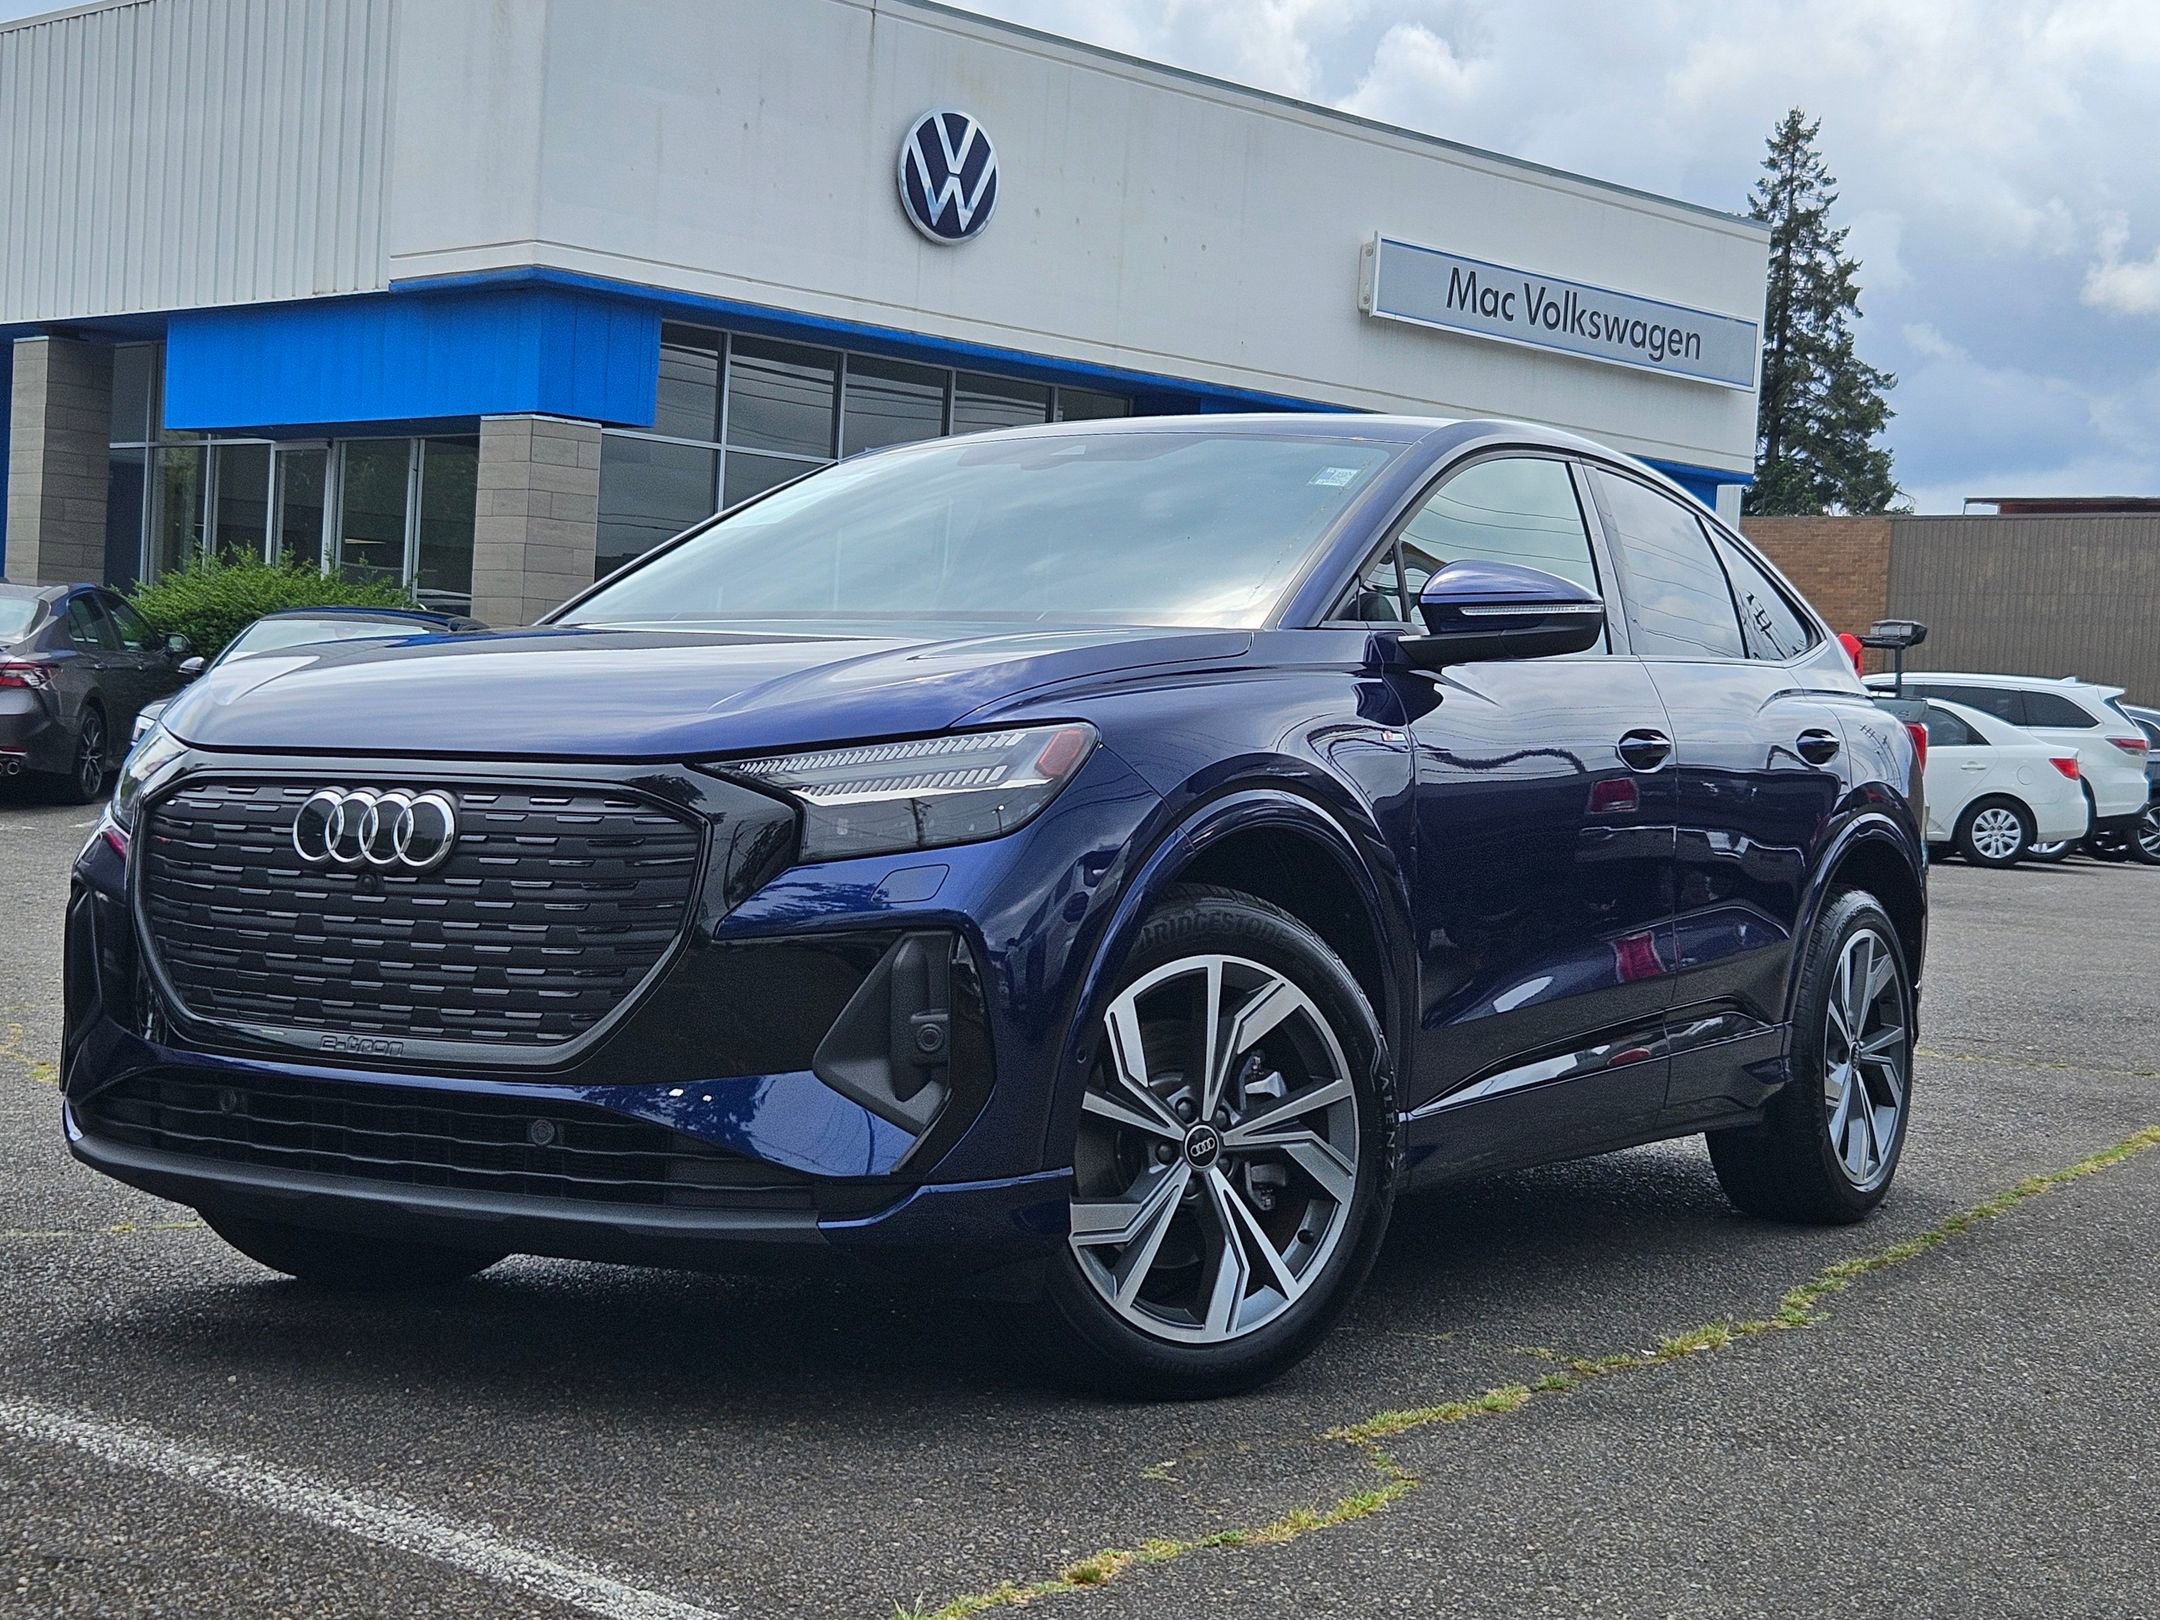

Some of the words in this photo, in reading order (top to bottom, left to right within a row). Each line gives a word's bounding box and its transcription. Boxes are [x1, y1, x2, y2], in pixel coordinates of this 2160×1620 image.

[1446, 266, 1515, 322] Mac
[1523, 281, 1702, 362] Volkswagen
[320, 1034, 404, 1056] e-tron
